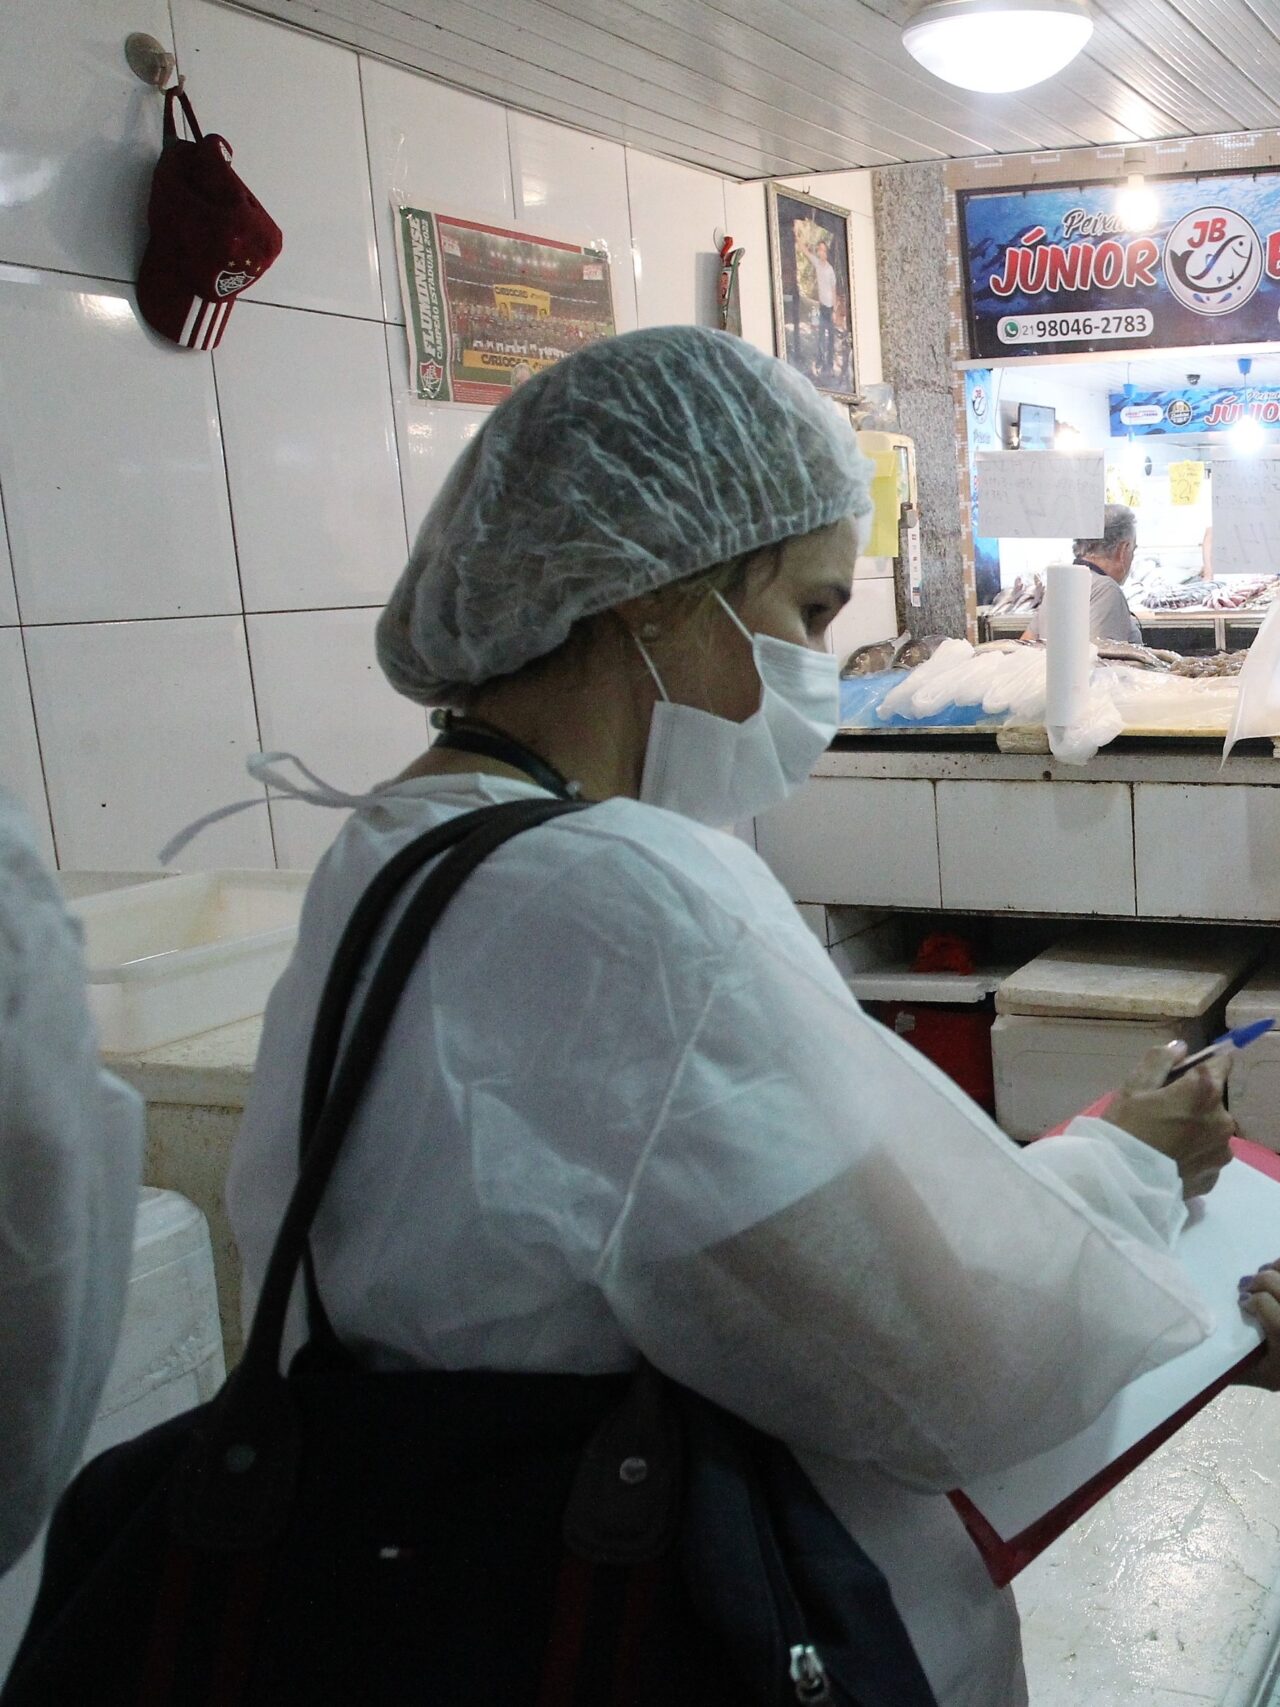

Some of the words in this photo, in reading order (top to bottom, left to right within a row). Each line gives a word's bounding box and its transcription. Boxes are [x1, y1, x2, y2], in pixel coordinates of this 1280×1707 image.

[1062, 207, 1142, 239] Peixa
[1187, 216, 1228, 249] JB
[424, 247, 438, 305] ESTADUAL
[989, 225, 1160, 297] JÚNIOR
[409, 215, 436, 357] FLUMINENSE
[1036, 314, 1147, 338] 98046-2783
